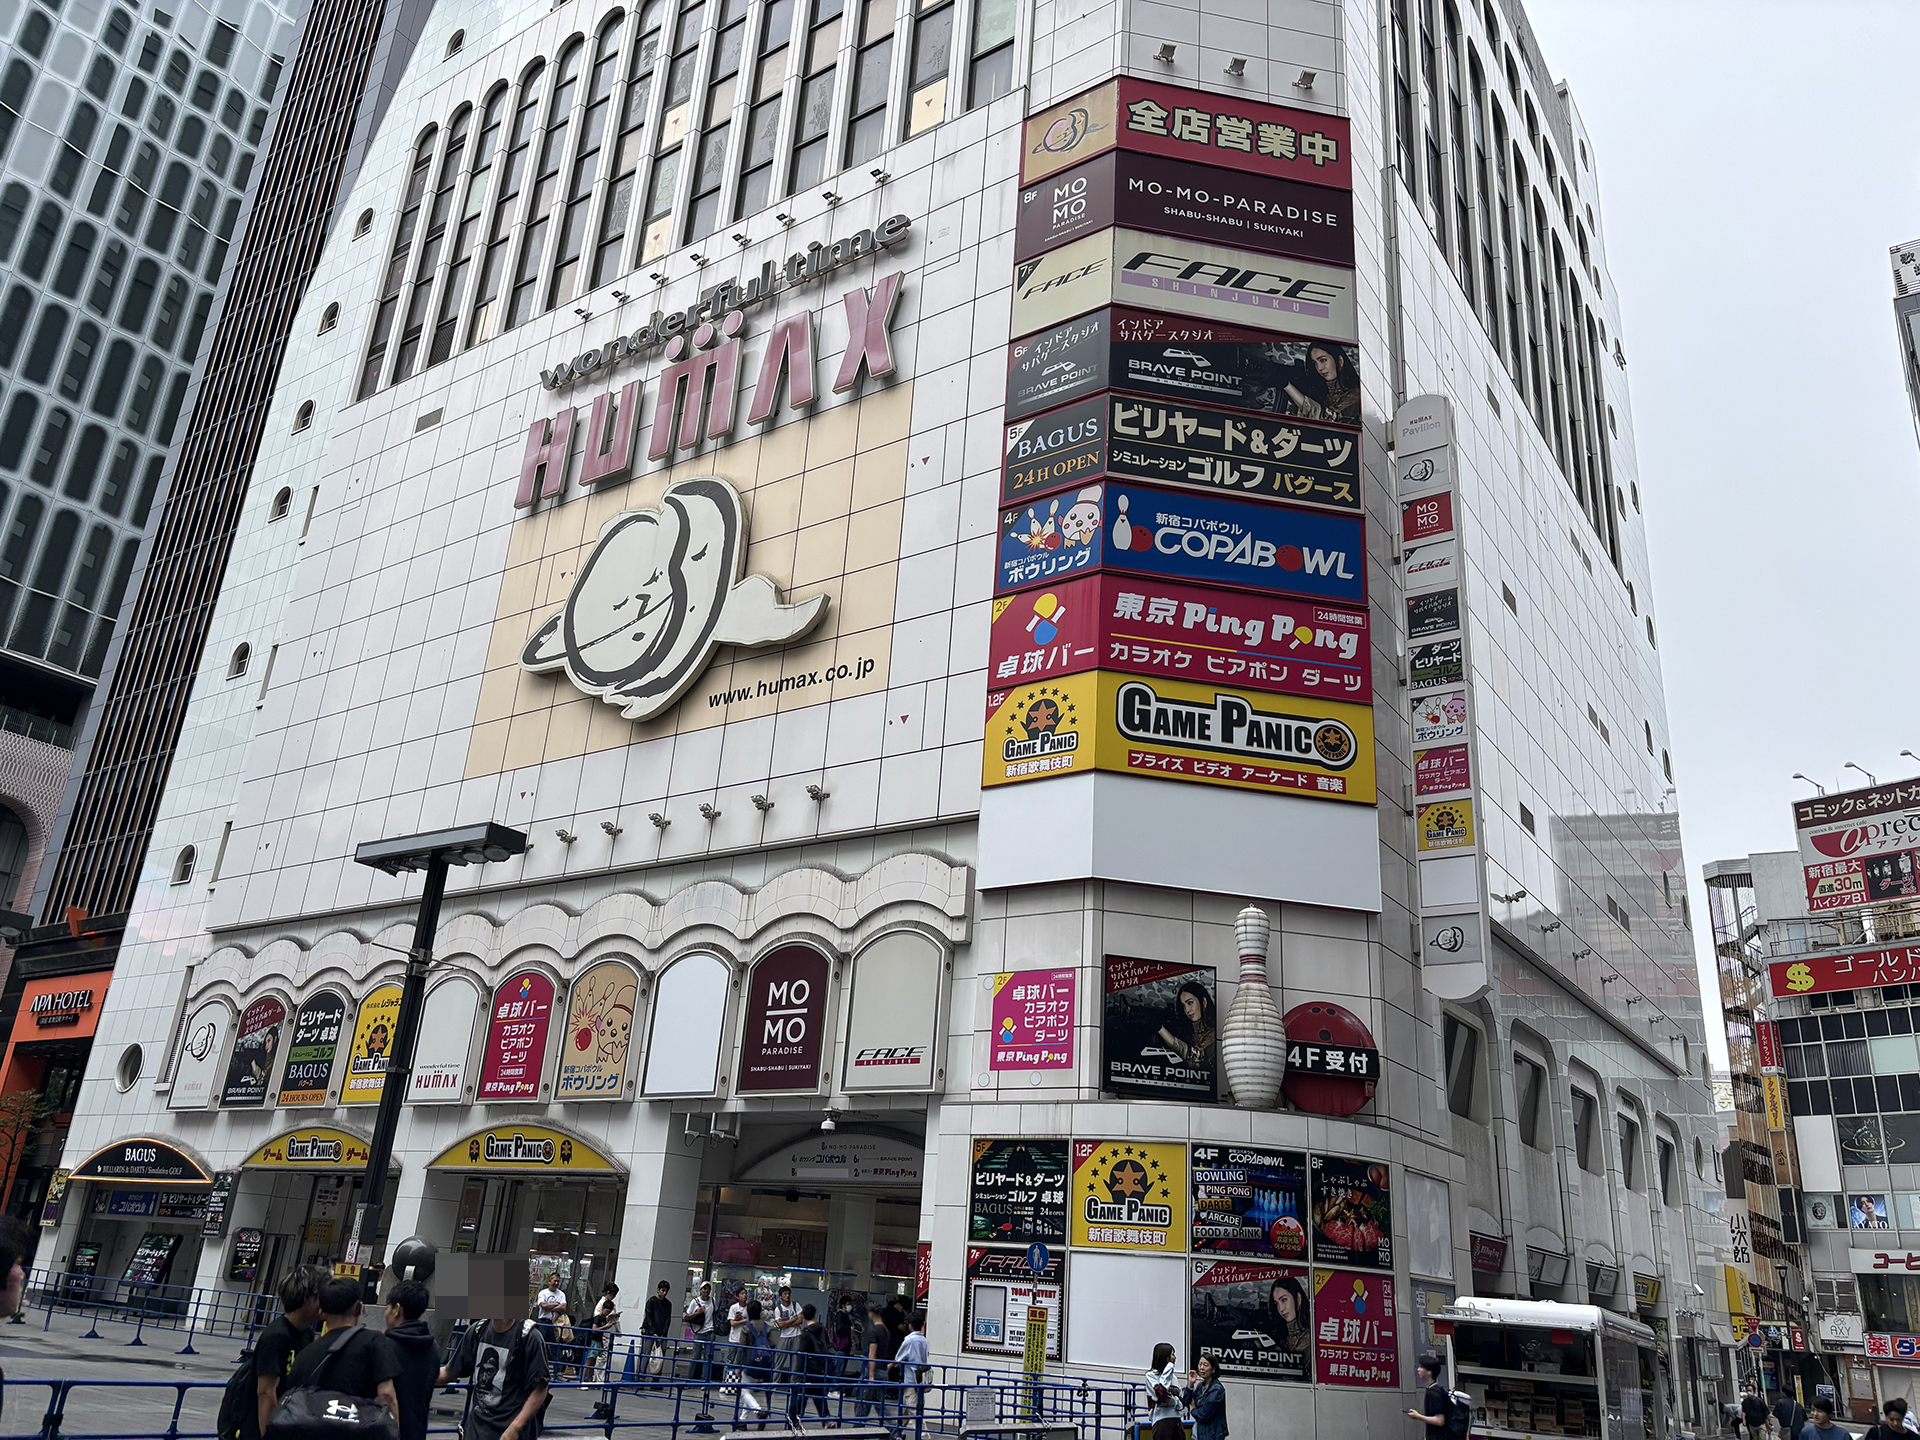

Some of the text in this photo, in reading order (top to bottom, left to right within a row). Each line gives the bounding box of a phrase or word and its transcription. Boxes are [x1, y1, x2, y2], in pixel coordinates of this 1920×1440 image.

[1125, 98, 1339, 167] 全店営業中
[1024, 191, 1038, 204] 8F
[1053, 177, 1087, 203] MO
[1128, 177, 1338, 228] MO-MO-PARADISE
[1052, 198, 1086, 224] MO
[1052, 213, 1086, 230] PARADISE
[1163, 206, 1304, 238] SHABU-SHABU SUKIYAKI
[1020, 265, 1034, 278] 7F
[1022, 258, 1108, 300] FACE
[1122, 251, 1346, 305] FACE
[539, 213, 912, 391] wonderful time
[1117, 319, 1164, 330] インドア
[1034, 326, 1072, 353] インドア
[1014, 346, 1028, 358] 6F
[1128, 358, 1243, 386] BRAVE POINT
[1017, 377, 1058, 397] BRAVE
[1060, 363, 1099, 383] POINT
[1009, 427, 1023, 440] 5F
[1113, 402, 1353, 468] ビリヤード&ダーツ
[1402, 420, 1441, 438] Pavilion
[1017, 417, 1098, 459] BAGUS
[1053, 451, 1100, 477] OPEN
[1272, 471, 1354, 503] バグース
[1416, 501, 1438, 515] MO
[1004, 512, 1019, 525] 4F
[1155, 511, 1243, 536] 新宿コパボウル
[1417, 514, 1438, 527] MO
[1008, 546, 1092, 583] ボウリング
[996, 601, 1008, 612] 2F
[1113, 592, 1178, 625] 東京
[1181, 602, 1264, 645] Ping
[1316, 610, 1364, 627] 24時間営業
[1431, 641, 1460, 655] ダーツ
[996, 642, 1095, 679] 卓球バー
[1110, 642, 1363, 691] カラオケ ビアポン ダーツ
[1415, 651, 1462, 669] ビリヤード
[708, 656, 875, 708] www.humax.co.jp
[1411, 676, 1448, 689] BAGUS
[1417, 726, 1464, 740] ボウリング
[1005, 755, 1074, 778] 新宿歌舞伎町
[1417, 756, 1466, 771] 卓球バー
[1130, 753, 1345, 793] プライズ ビデオ アーケード 音楽
[1808, 859, 1862, 879] 新宿最大
[767, 979, 810, 1007] MO
[1012, 983, 1069, 1001] 卓球バー
[53, 990, 90, 1010] HOTEL
[1024, 1000, 1069, 1014] カラオケ
[496, 999, 548, 1019] 卓球バー
[300, 1008, 343, 1026] ビリヤード
[1024, 1015, 1069, 1028] ビアポン
[296, 1025, 339, 1043] ダーツ 卓球
[502, 1024, 535, 1036] カラオケ
[763, 1017, 806, 1045] MO
[1034, 1029, 1068, 1042] ダーツ
[500, 1037, 533, 1049] ビアポン
[761, 1045, 803, 1056] PARADISE
[501, 1051, 527, 1064] ダーツ
[855, 1045, 927, 1060] FACE
[996, 1051, 1039, 1064] 東京 Ping
[288, 1062, 329, 1079] BAGUS
[1111, 1061, 1211, 1080] BRAVE POINT
[227, 1086, 265, 1094] BRAVE POINT
[484, 1081, 515, 1094] 東京 Ping
[561, 1073, 620, 1092] ボウリング
[290, 1092, 324, 1102] HOURS OPEN
[263, 1148, 283, 1161] ゲーム
[346, 1148, 368, 1161] ゲーム
[976, 1142, 986, 1152] 5F
[1194, 1148, 1219, 1160] 4F
[125, 1148, 157, 1162] BAGUS
[1311, 1157, 1324, 1169] 8F
[976, 1172, 1065, 1188] ビリヤード&ダーツ
[1196, 1171, 1244, 1181] BOWLING
[1321, 1173, 1368, 1188] しゃぶしゃぶ
[1041, 1190, 1064, 1204] 卓球
[1206, 1185, 1250, 1196] PING PONG
[1320, 1186, 1353, 1199] すき焼き
[974, 1202, 1013, 1215] BAGUS
[1201, 1200, 1231, 1209] DARTS
[1208, 1213, 1240, 1226] ARCADE
[1087, 1226, 1167, 1247] 新宿歌舞伎町
[1195, 1227, 1260, 1238] FOOD & DRINK
[1729, 1213, 1750, 1263] 小次郎
[1378, 1236, 1390, 1248] MO
[971, 1249, 981, 1260] 7F
[1378, 1251, 1391, 1262] MO
[1195, 1261, 1208, 1274] 6F
[1210, 1265, 1237, 1275] インドア
[1315, 1274, 1326, 1285] 2F
[1318, 1316, 1393, 1345] 卓球バー
[1830, 1325, 1851, 1336] AXY
[1200, 1346, 1303, 1364] BRAVE POINT
[1319, 1348, 1395, 1362] カラオケ ビアポン ダーツ
[1329, 1363, 1370, 1382] 東京 Ping
